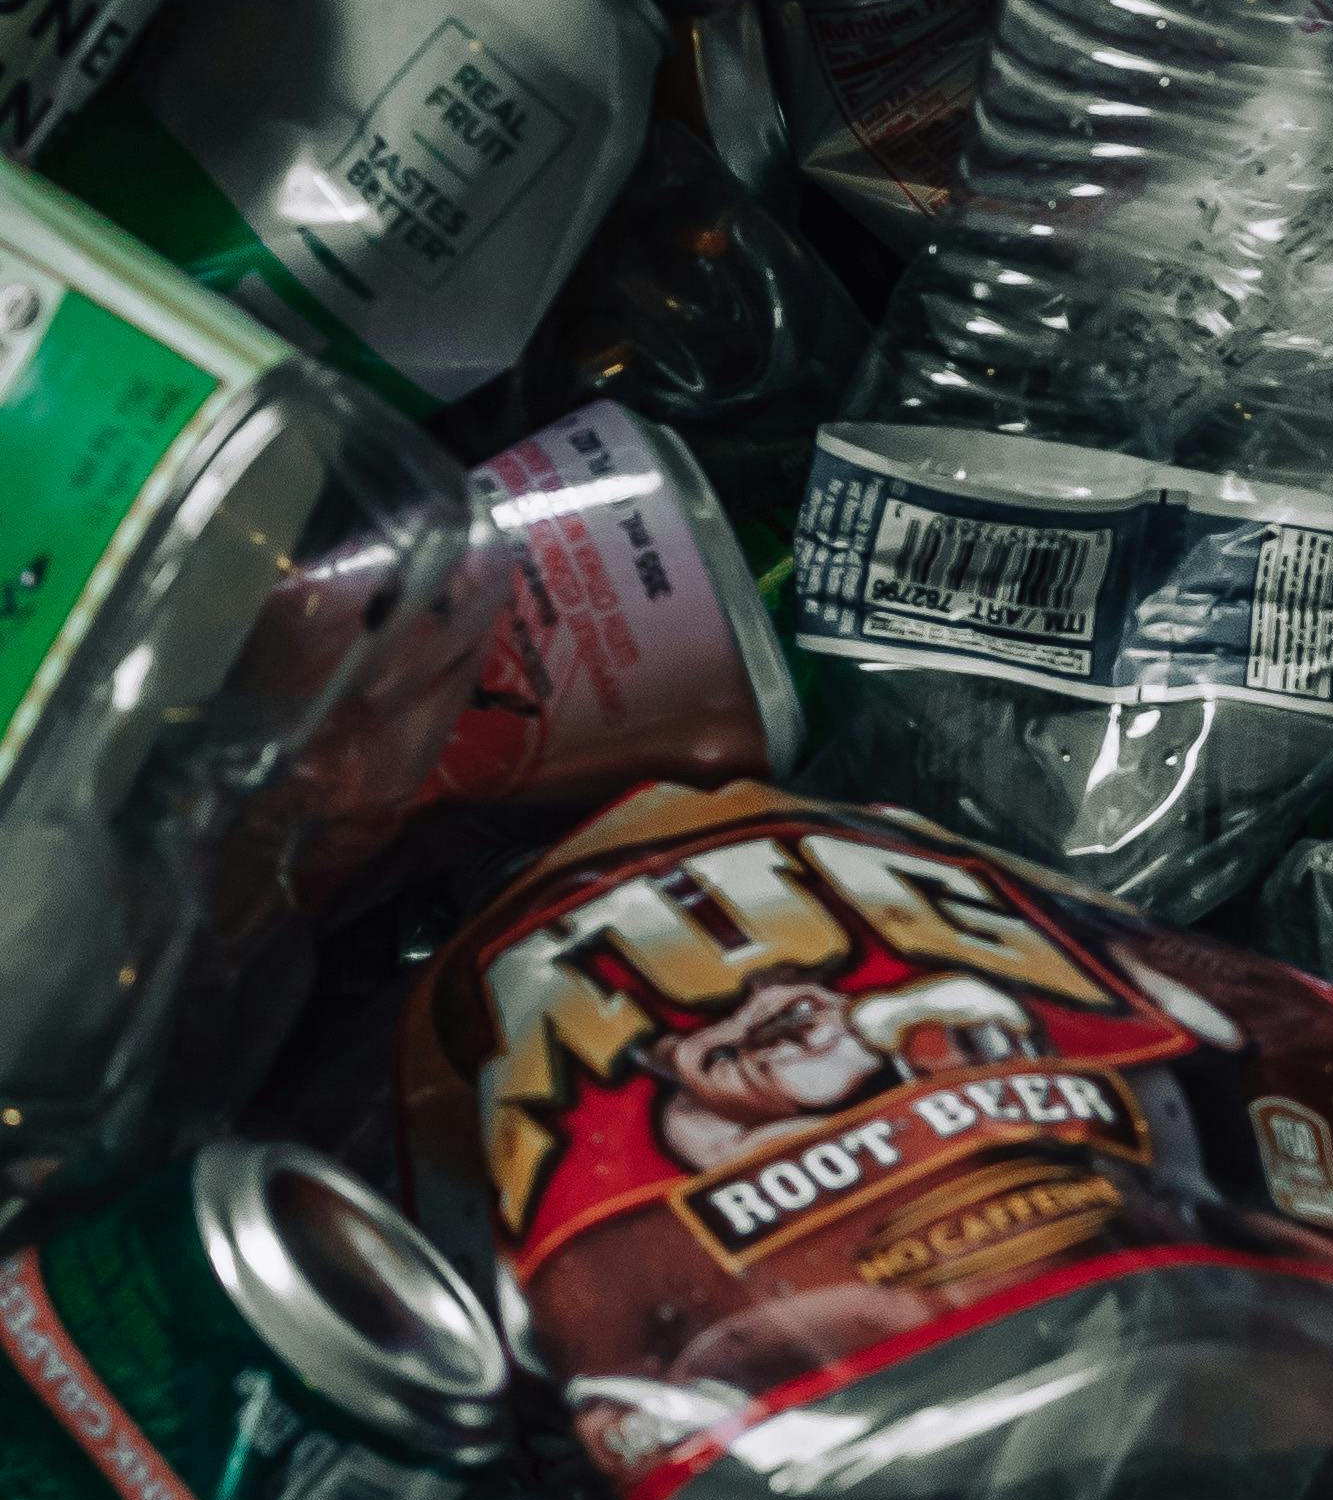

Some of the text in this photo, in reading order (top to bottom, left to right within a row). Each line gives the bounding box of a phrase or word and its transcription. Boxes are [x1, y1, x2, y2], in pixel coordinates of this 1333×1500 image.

[426, 88, 517, 168] FRUIT
[452, 62, 531, 142] REAL
[371, 134, 471, 238] TASTES
[707, 1070, 1119, 1242] ROOT BEER
